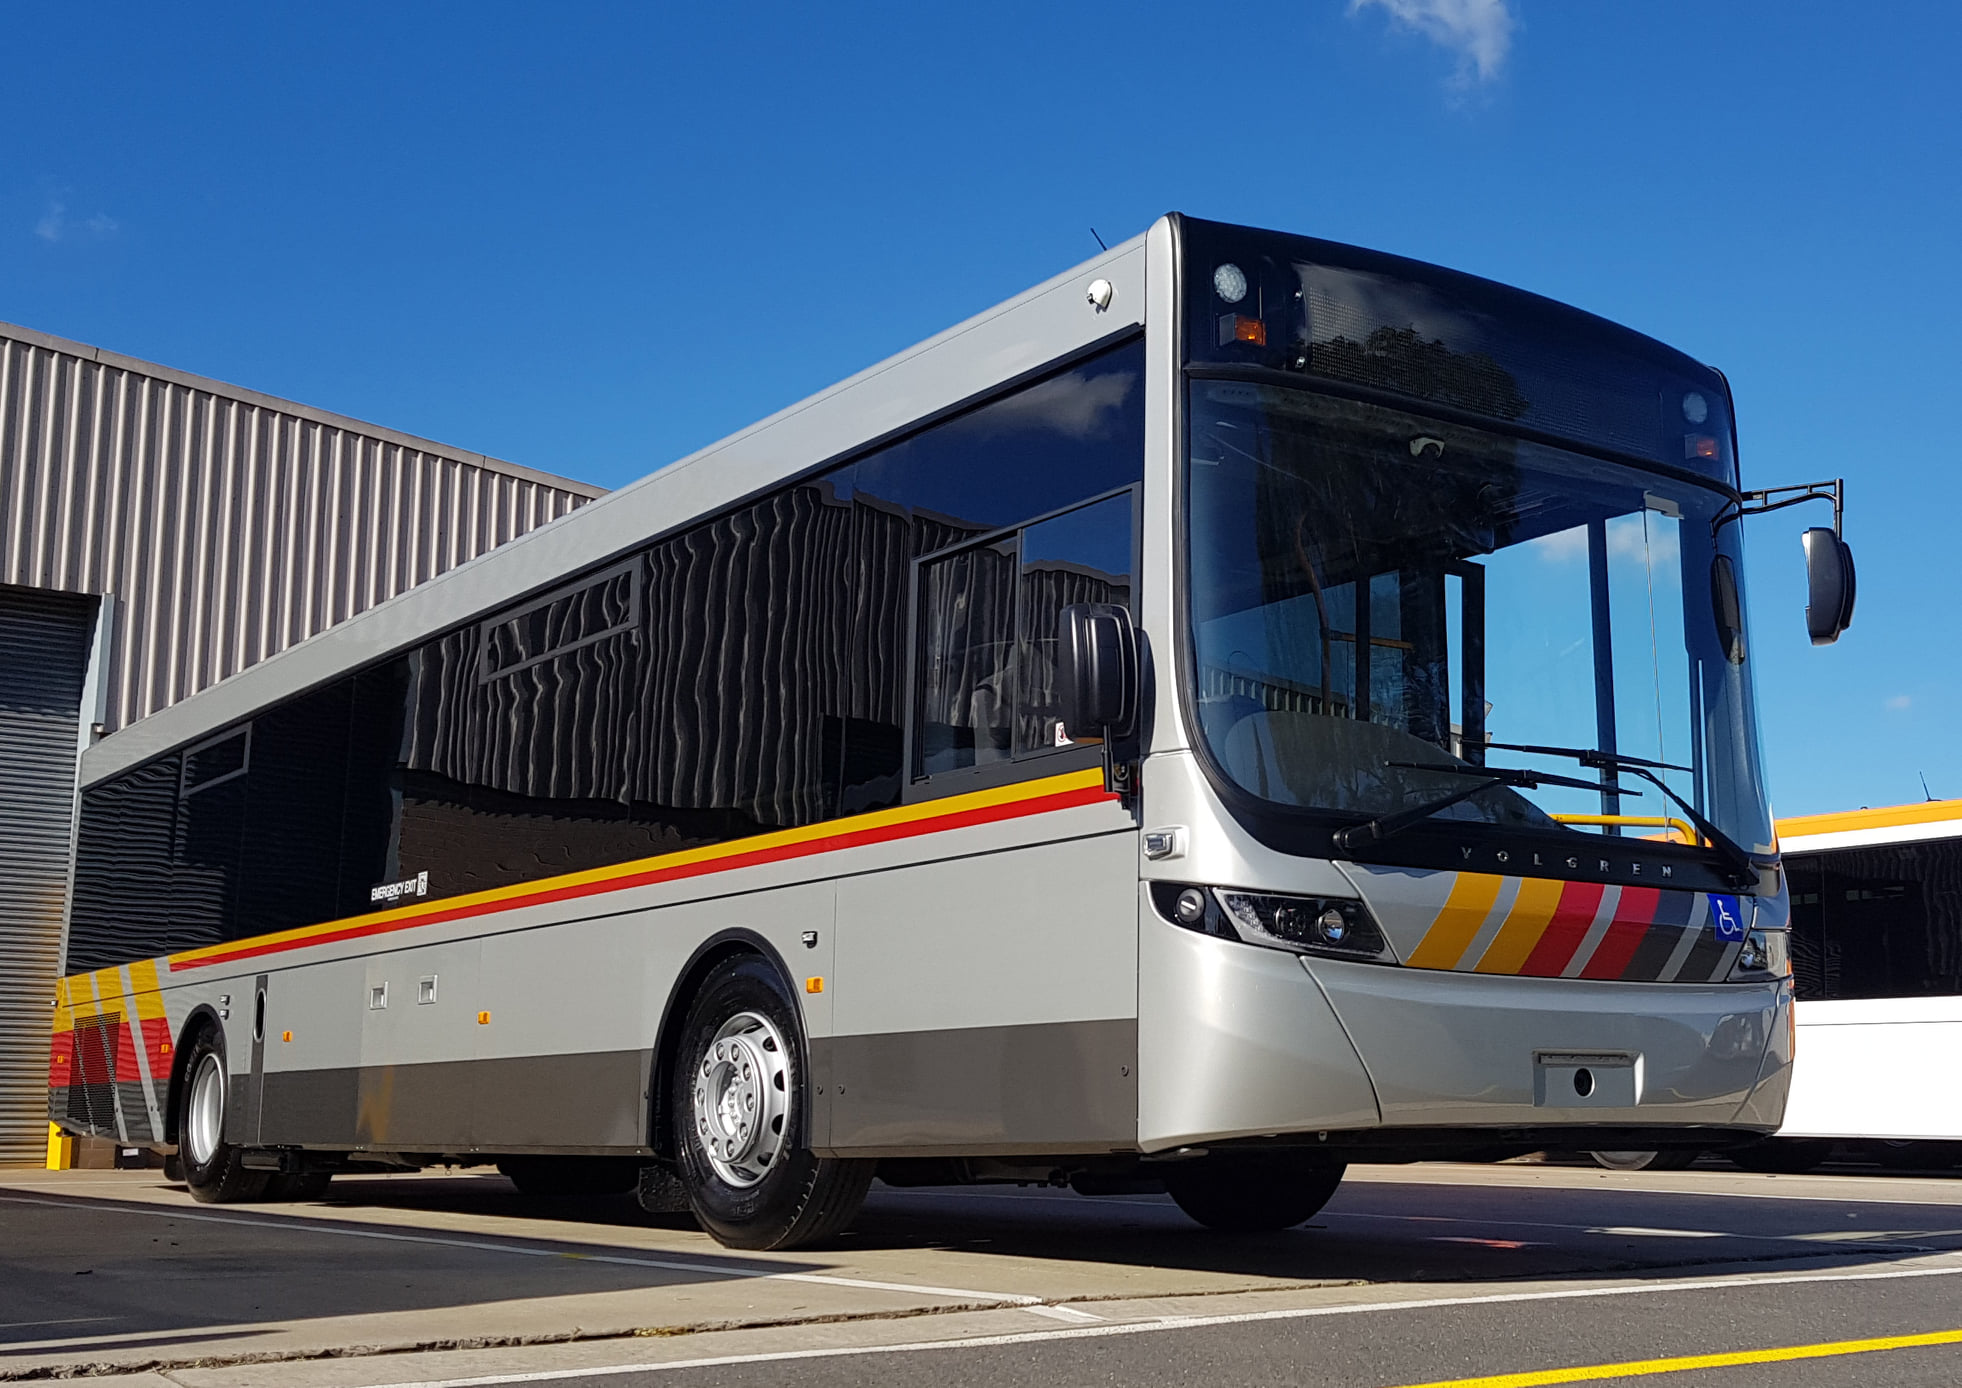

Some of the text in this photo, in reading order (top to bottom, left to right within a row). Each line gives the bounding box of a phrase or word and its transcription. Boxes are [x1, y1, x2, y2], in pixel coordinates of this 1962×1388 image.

[1461, 847, 1672, 878] VOLGREN
[371, 879, 417, 901] EMERGENCY EXIT
